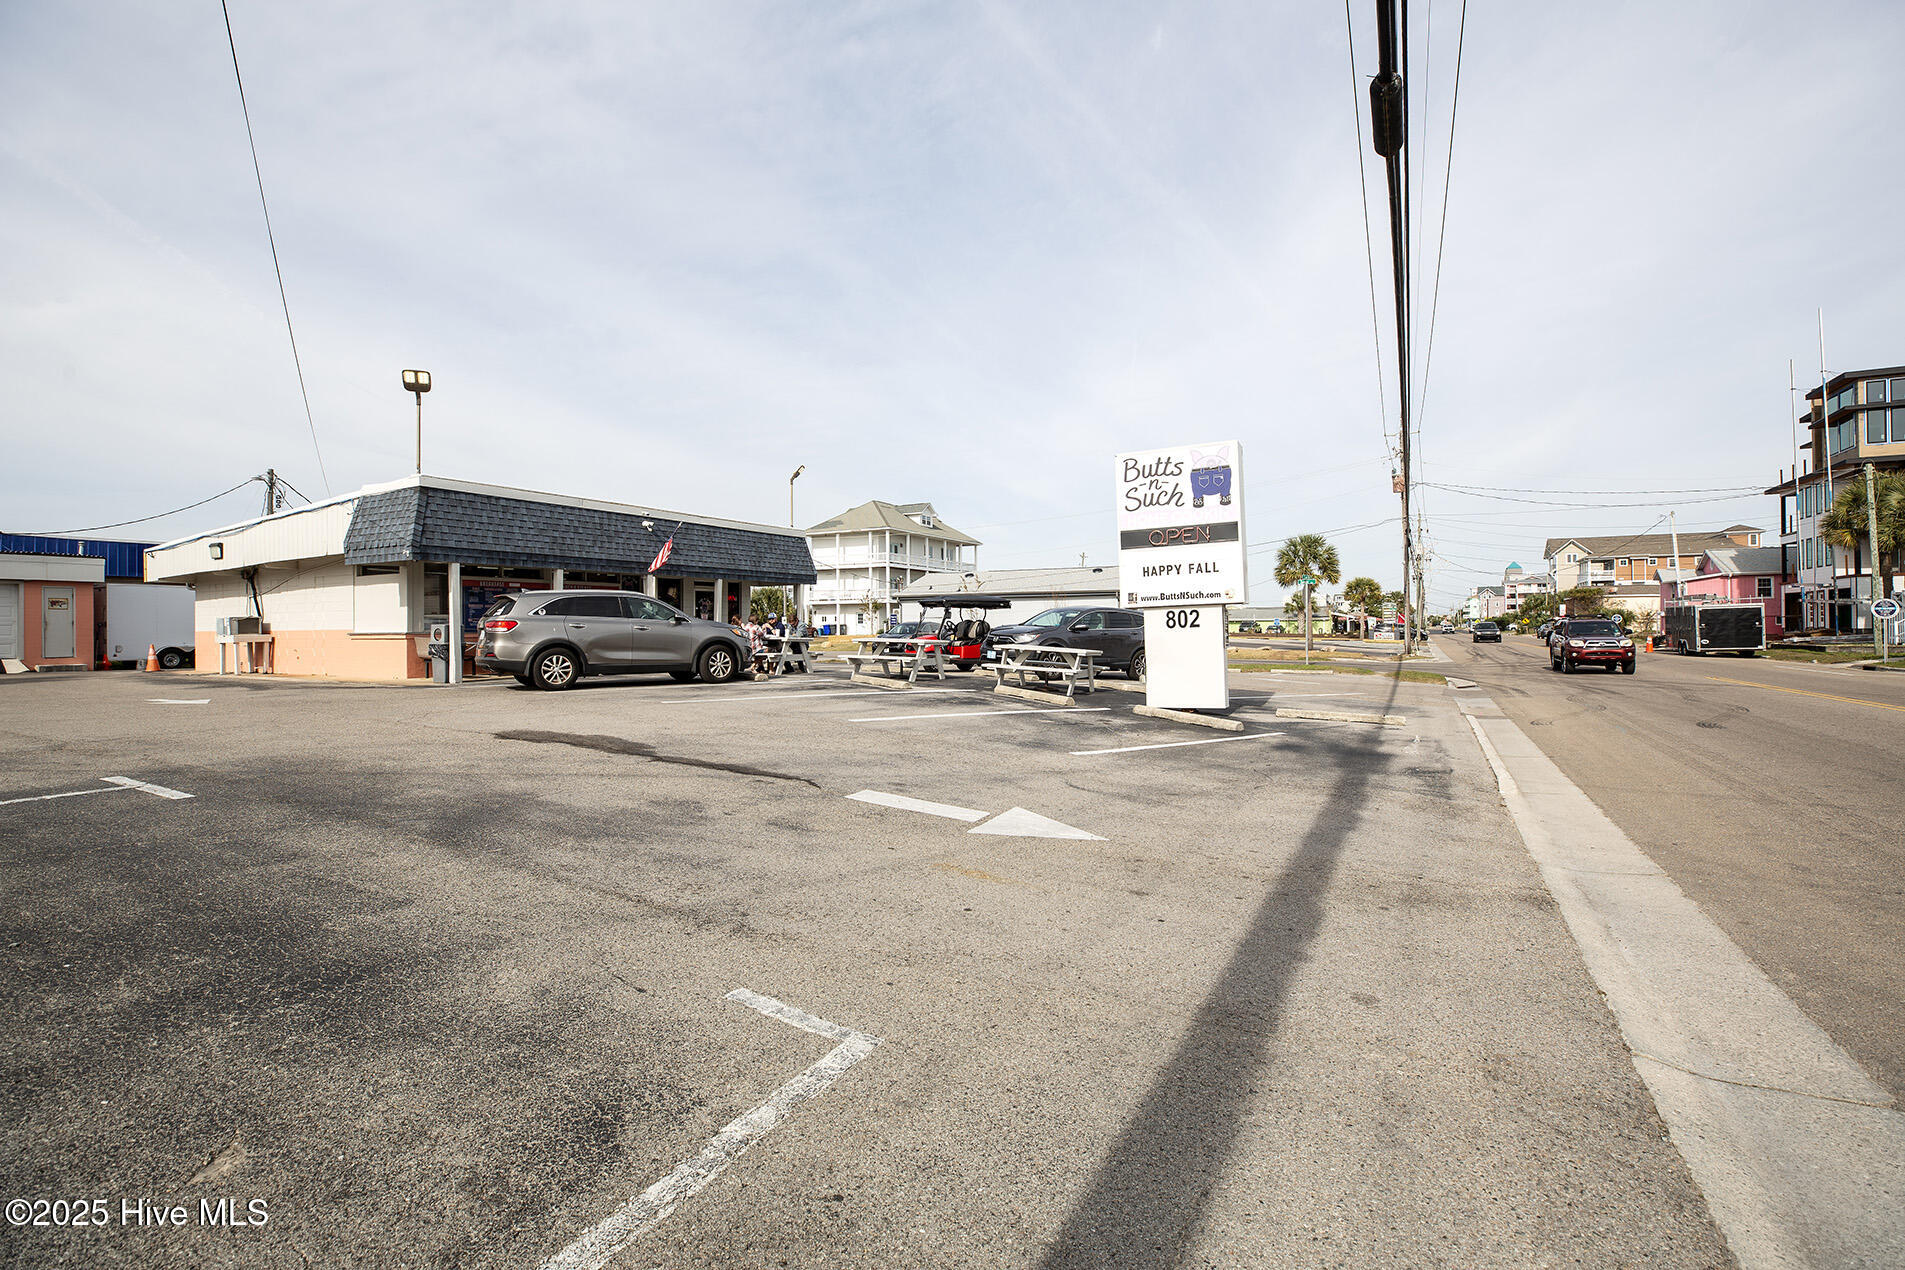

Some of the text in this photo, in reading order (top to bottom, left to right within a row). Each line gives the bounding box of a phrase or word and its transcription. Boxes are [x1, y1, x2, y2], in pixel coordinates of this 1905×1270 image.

[1123, 456, 1184, 483] Butts
[1125, 482, 1185, 512] Such
[1148, 526, 1210, 546] OPEN
[1142, 562, 1220, 577] HAPPY FALL
[1140, 591, 1222, 602] www.ButtsNSuch.com
[1166, 609, 1201, 629] 802
